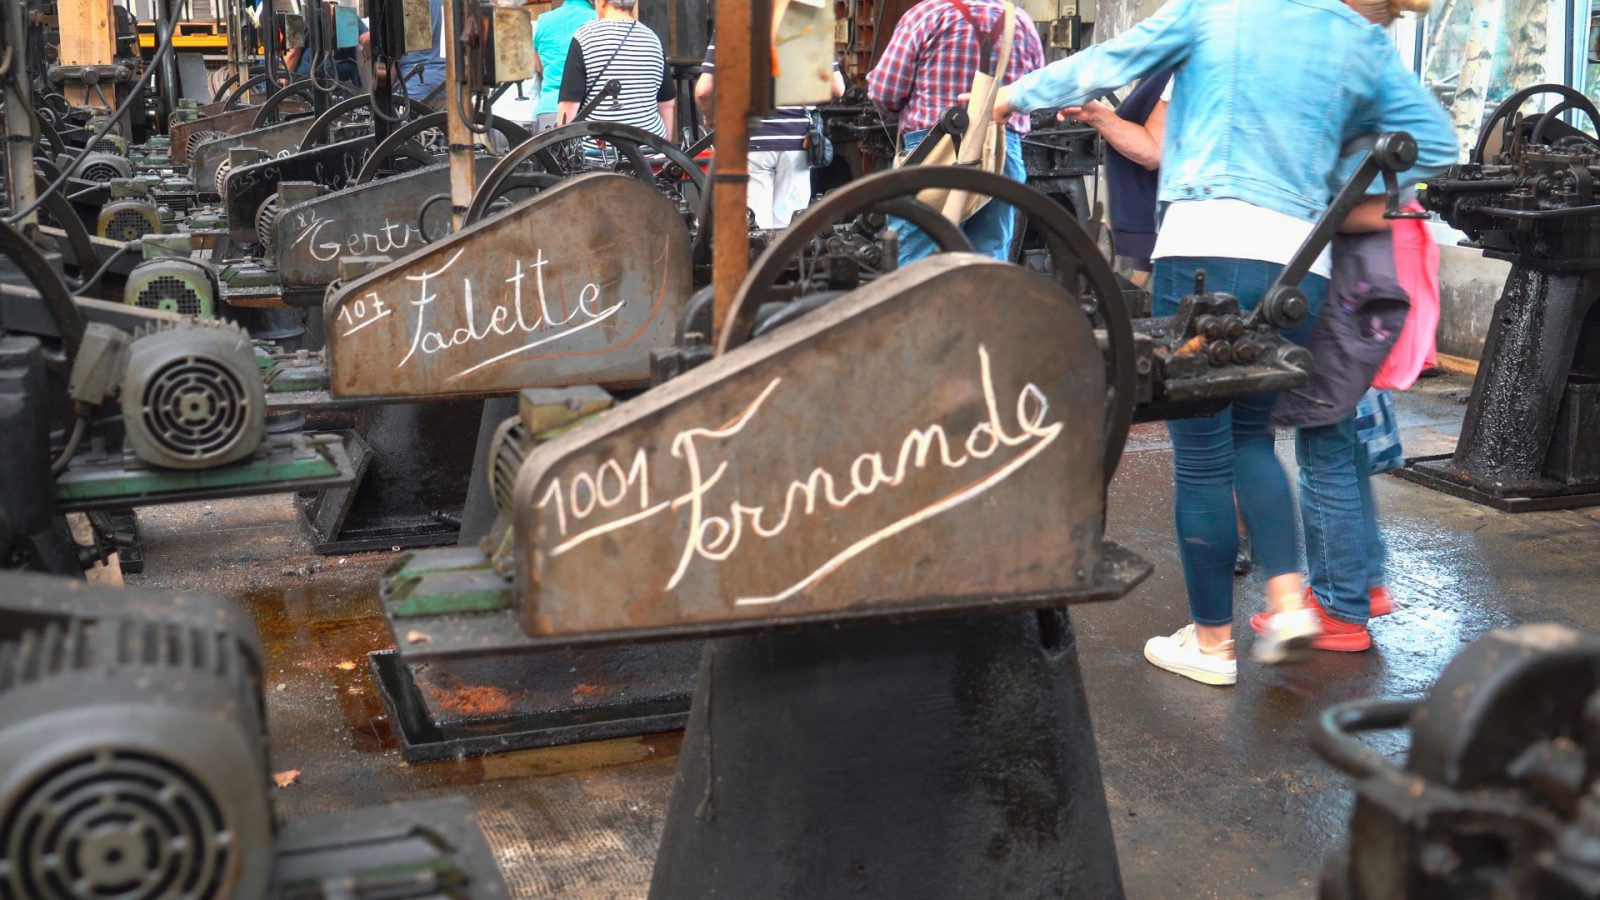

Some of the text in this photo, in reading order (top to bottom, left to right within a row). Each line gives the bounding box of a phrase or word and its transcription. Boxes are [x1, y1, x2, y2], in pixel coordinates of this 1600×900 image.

[337, 247, 608, 369] 107 Fadette
[538, 343, 1058, 592] 1001 Fernande
